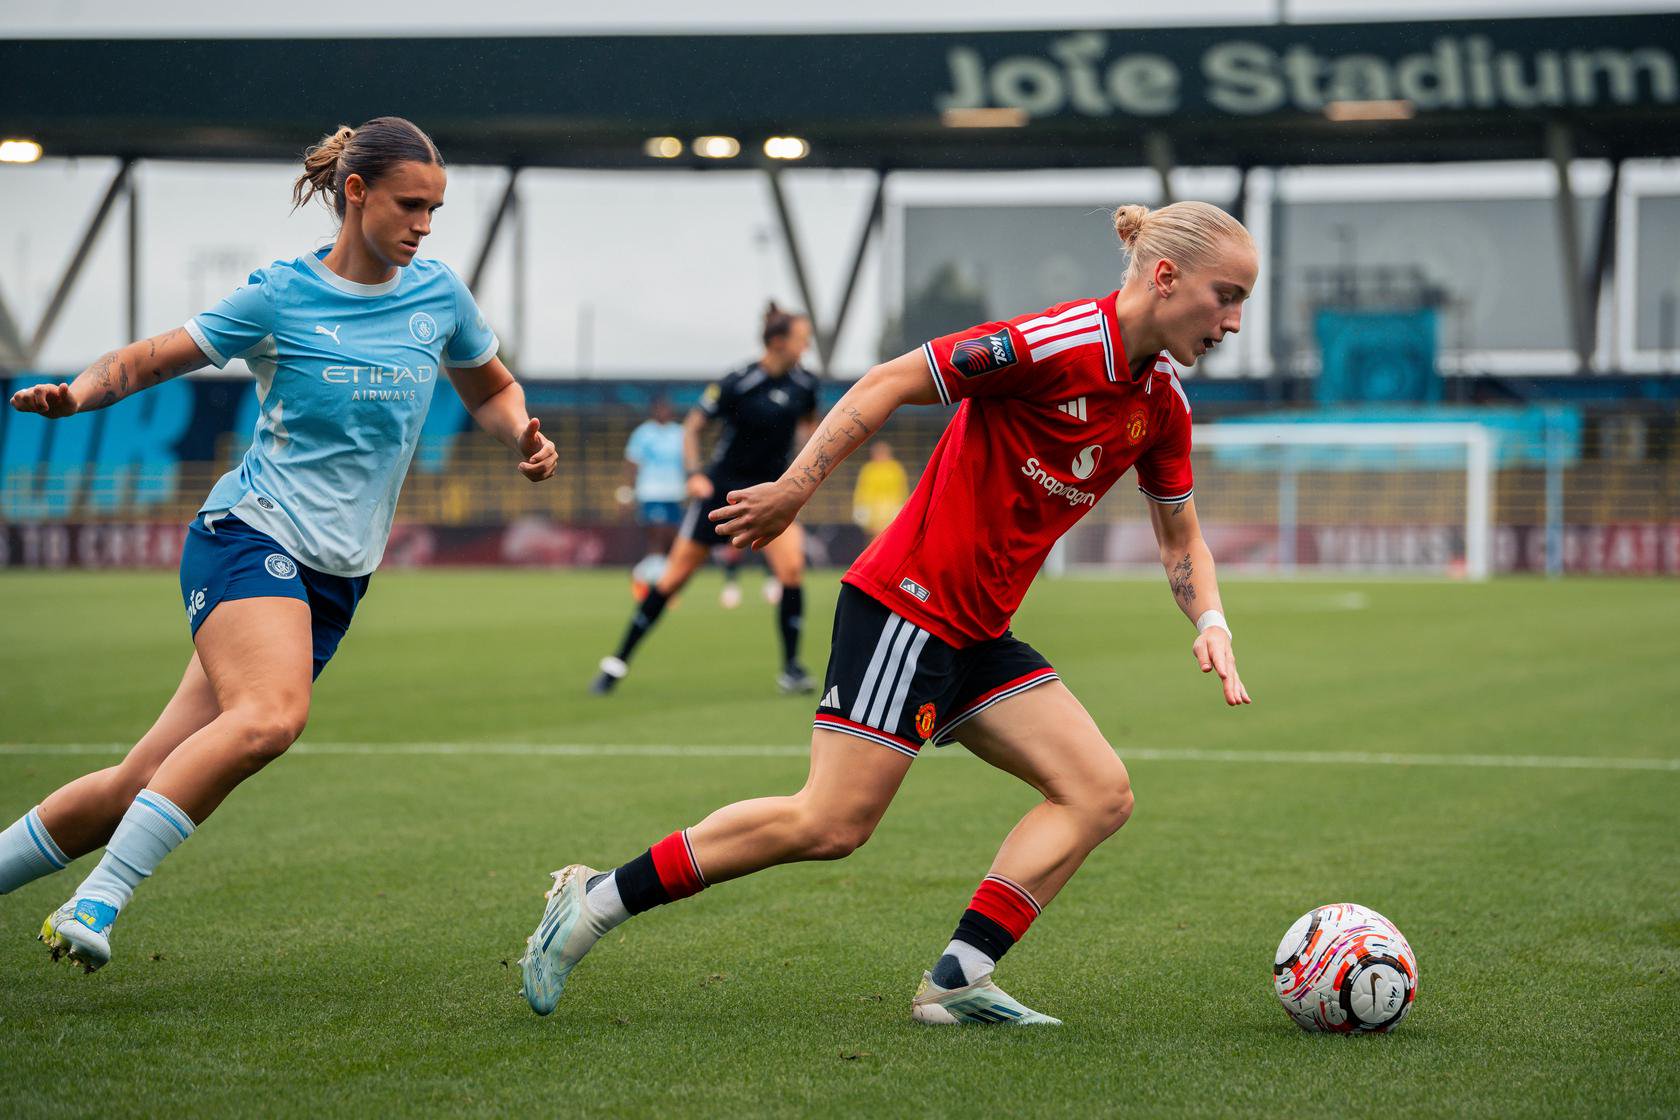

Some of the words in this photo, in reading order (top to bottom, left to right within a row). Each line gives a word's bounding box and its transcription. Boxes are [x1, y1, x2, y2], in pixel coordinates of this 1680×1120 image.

[935, 32, 1181, 117] Joie
[1202, 35, 1676, 115] Stadium
[990, 336, 1007, 365] WSL
[322, 365, 433, 385] ETIHAD
[352, 389, 416, 401] AIRWAYS
[186, 589, 206, 624] oie
